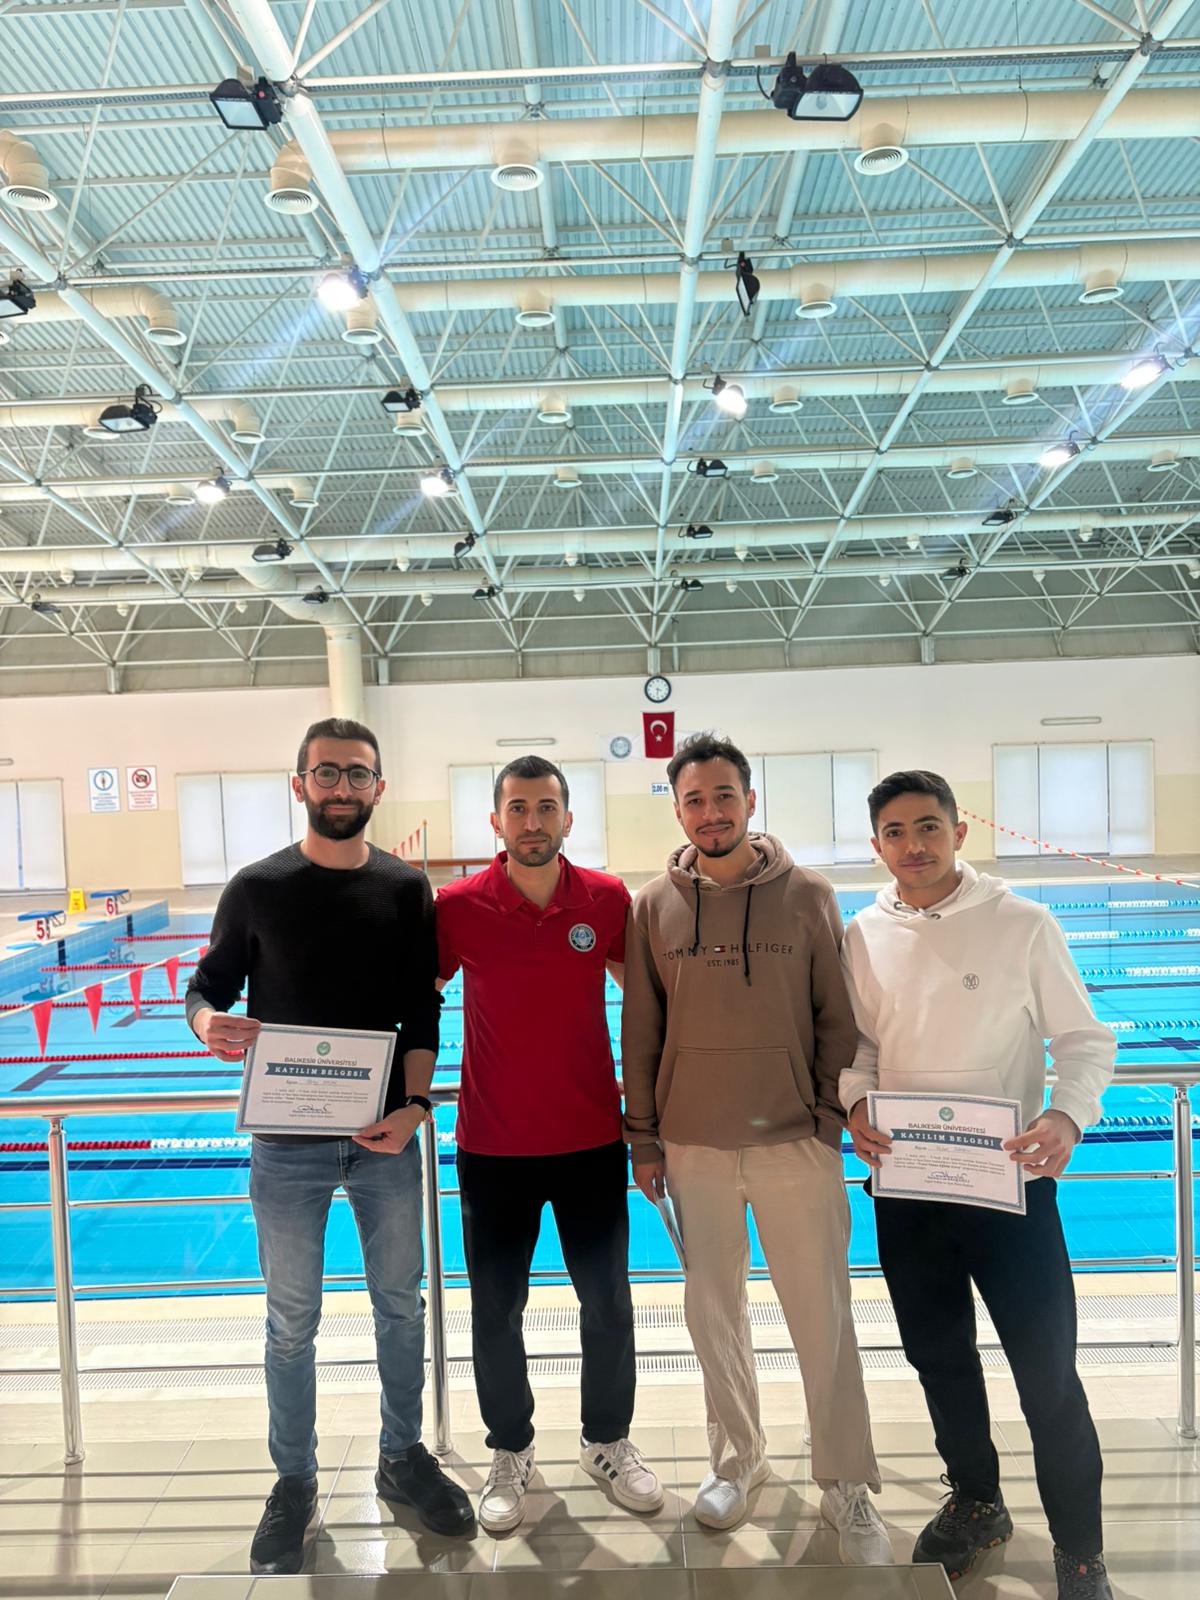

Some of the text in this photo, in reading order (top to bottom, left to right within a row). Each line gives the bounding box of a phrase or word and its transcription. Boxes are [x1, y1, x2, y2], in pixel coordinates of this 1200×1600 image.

[106, 897, 114, 915] 6
[36, 920, 45, 940] 5
[275, 1066, 318, 1075] KATILIM
[900, 1132, 946, 1141] KATILIM
